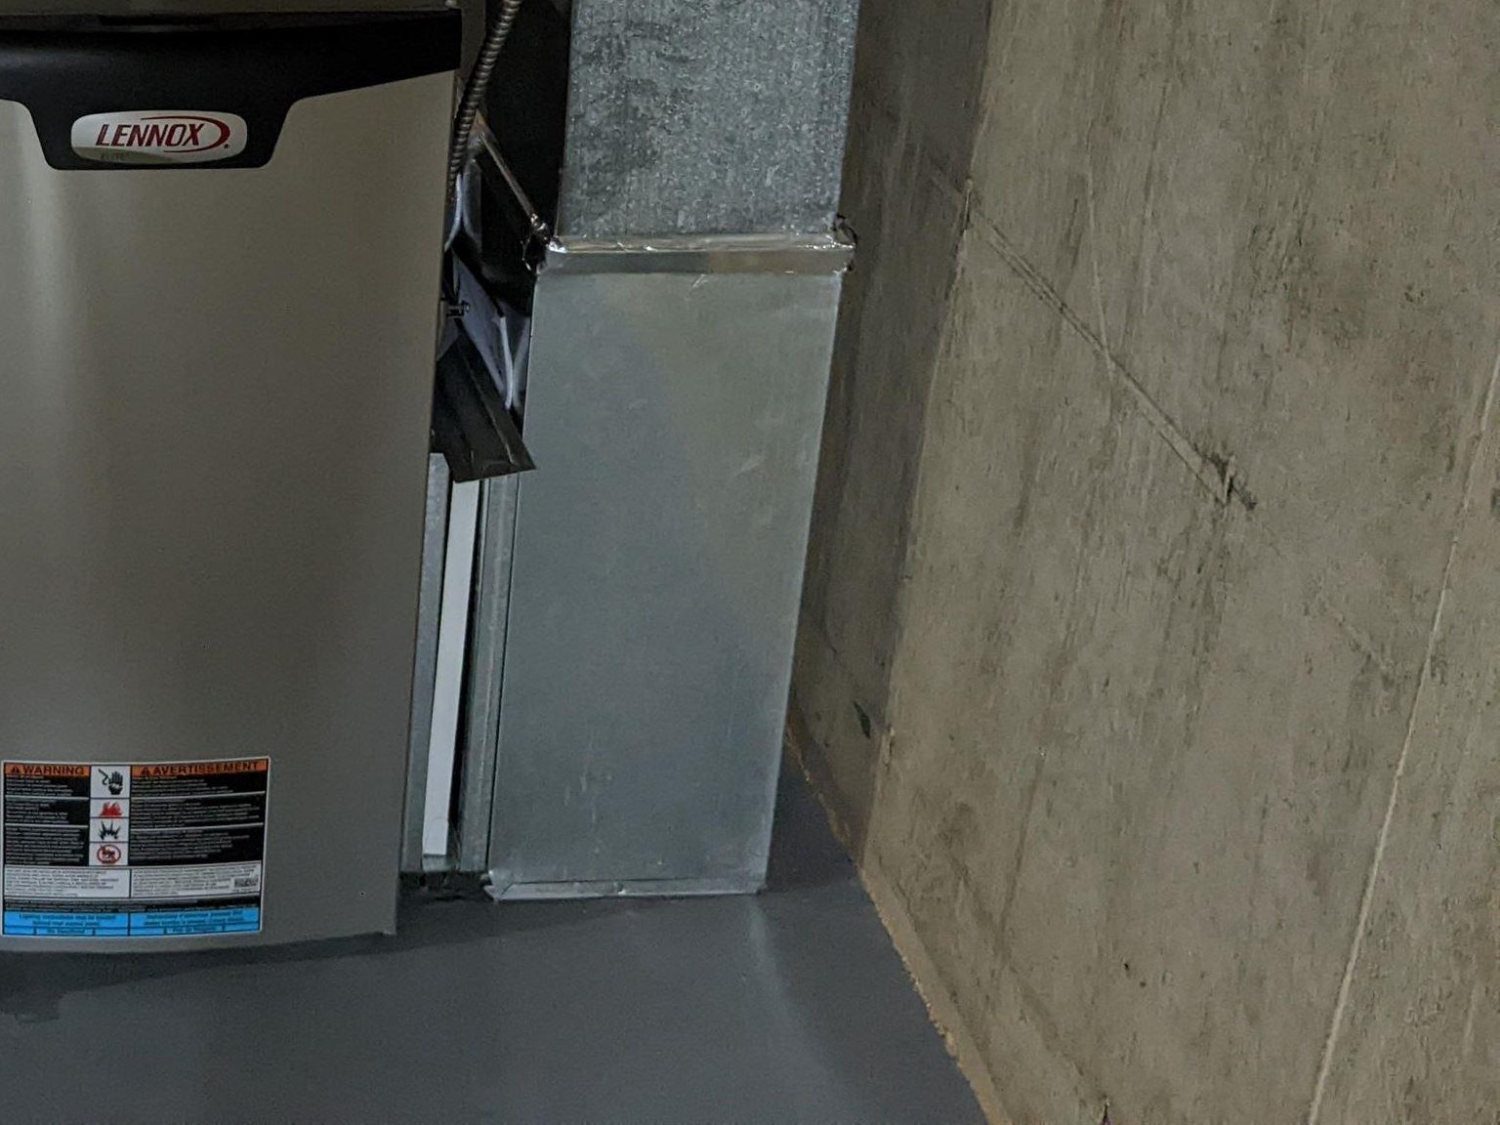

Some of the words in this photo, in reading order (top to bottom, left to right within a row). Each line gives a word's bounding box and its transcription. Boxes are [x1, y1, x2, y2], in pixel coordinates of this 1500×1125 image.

[96, 123, 205, 147] LENNOX
[23, 764, 85, 775] WARNING
[154, 761, 259, 775] AVERTISSEMENT
